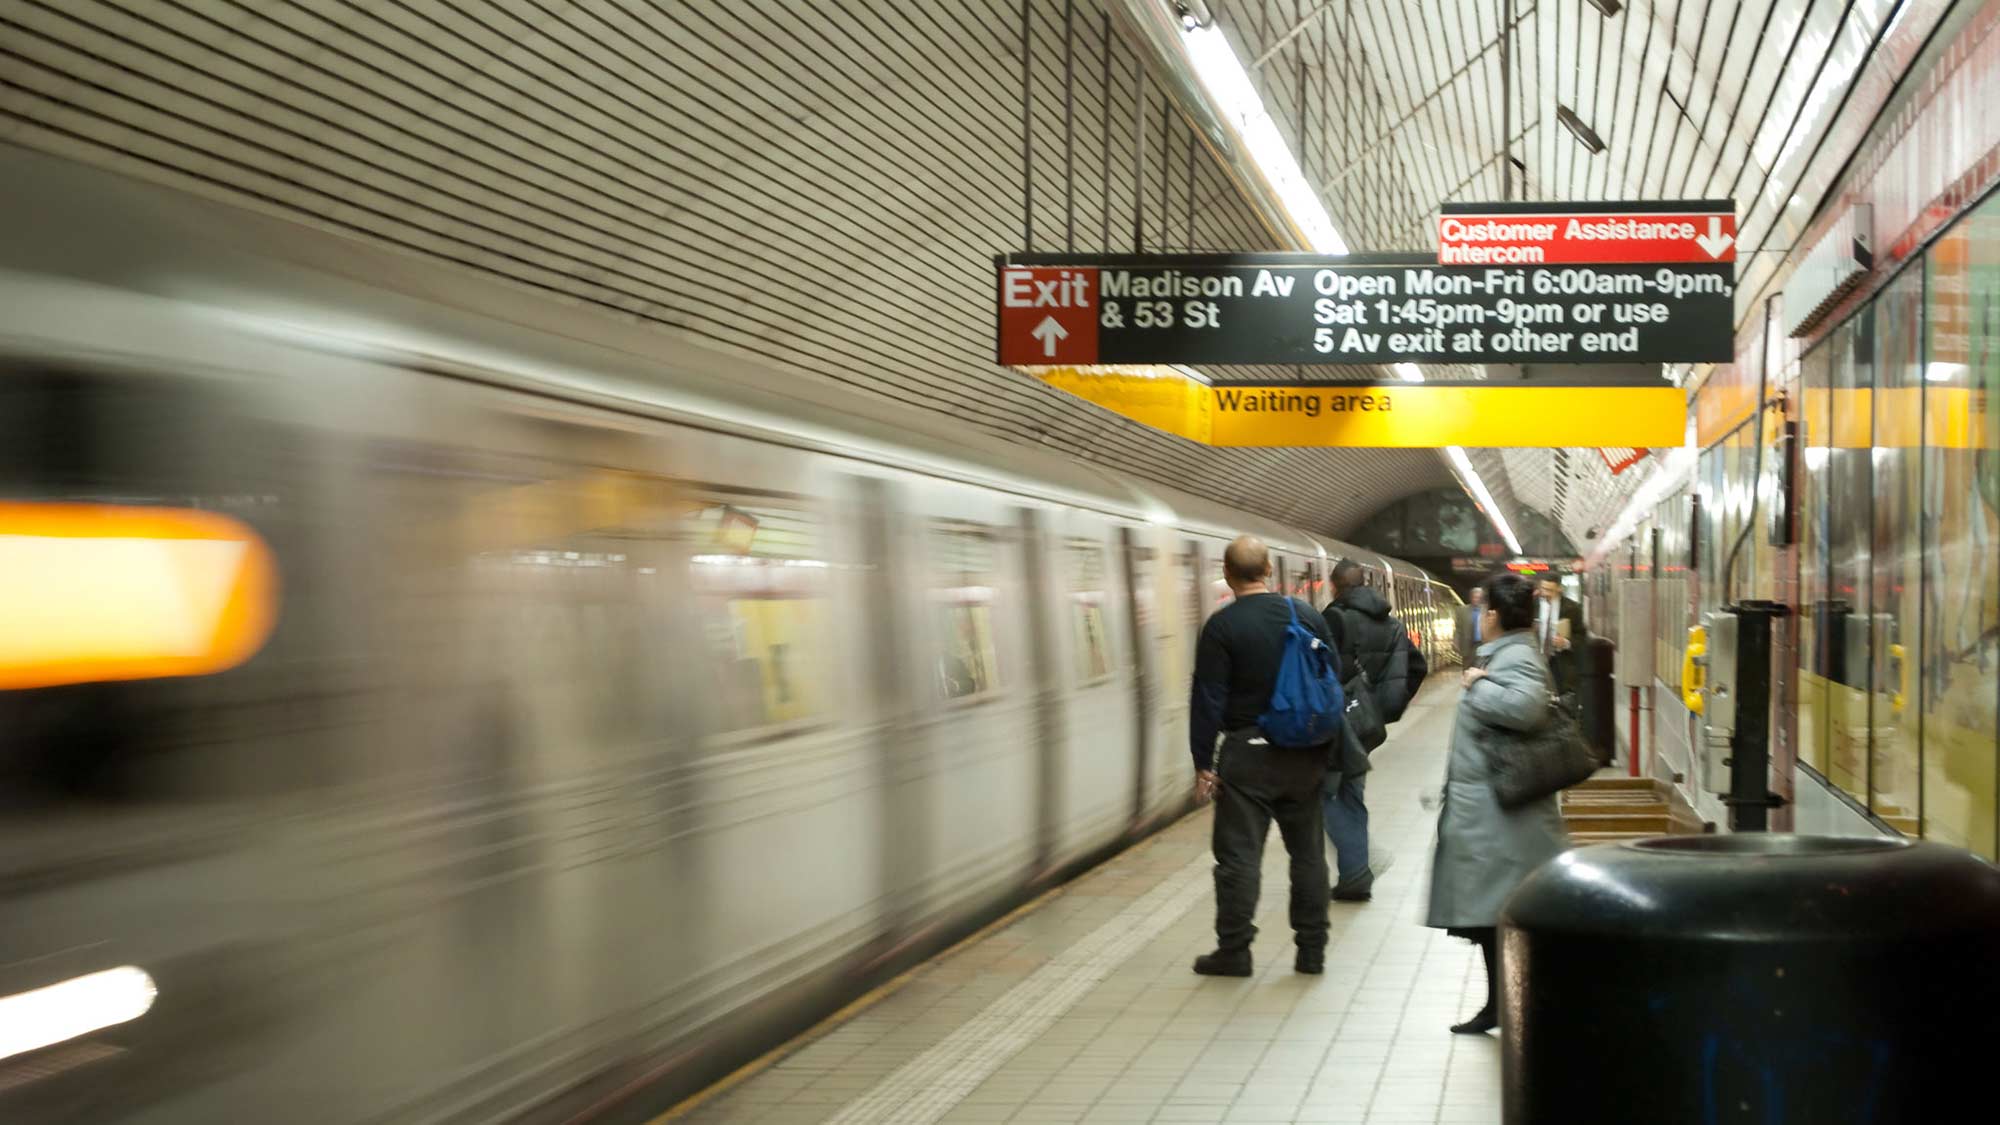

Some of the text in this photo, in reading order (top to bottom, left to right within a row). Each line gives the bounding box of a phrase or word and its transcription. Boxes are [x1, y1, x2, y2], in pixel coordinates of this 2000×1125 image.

[1441, 218, 1696, 242] Customer Assistance
[1442, 243, 1544, 263] Intercom
[1004, 270, 1089, 308] Exit
[1101, 269, 1295, 298] Madison Av
[1313, 269, 1733, 300] Open Mon-Fri 6:00am-9pm,
[1101, 301, 1221, 328] & 53 St
[1313, 298, 1670, 328] Sat 1:45pm-9pm or use
[1313, 326, 1640, 354] 5 Av exit at other end
[1216, 390, 1392, 417] Waiting area
